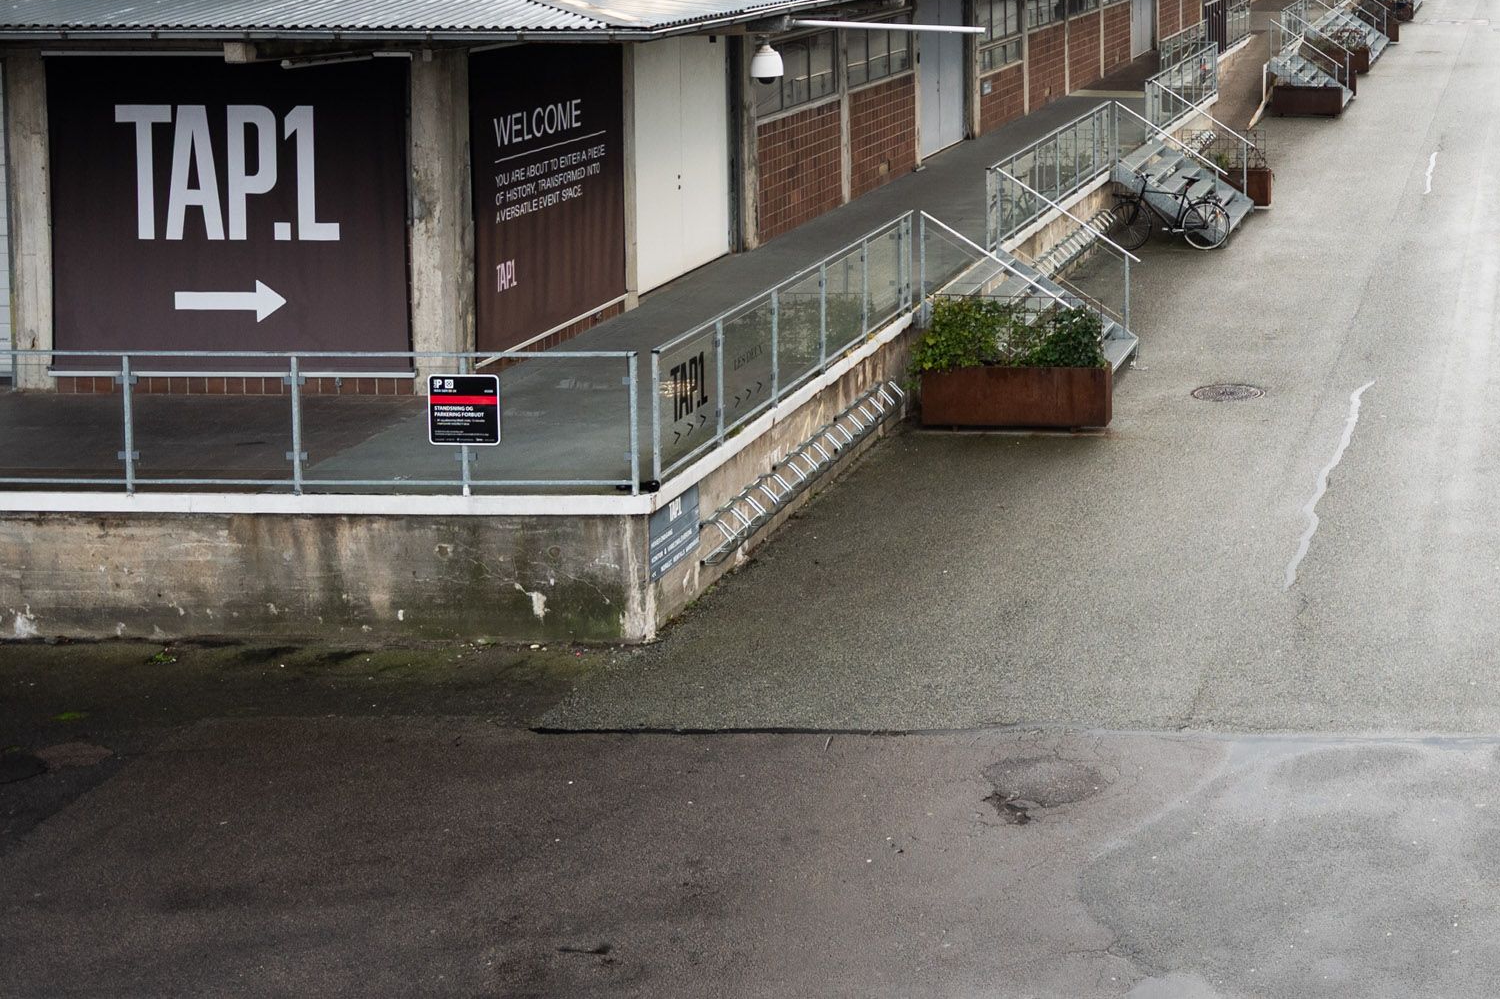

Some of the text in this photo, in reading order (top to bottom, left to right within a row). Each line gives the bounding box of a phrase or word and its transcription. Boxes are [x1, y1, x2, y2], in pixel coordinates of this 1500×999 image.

[493, 99, 582, 147] WELCOME
[114, 104, 341, 241] TAP.1
[495, 144, 606, 188] YOU ARE ABOUT TO ENTER A PIECE
[495, 162, 601, 206] OF HISTORY, TRANSFORMED INTO
[501, 198, 538, 222] VERSATILE
[539, 191, 561, 210] EVENT
